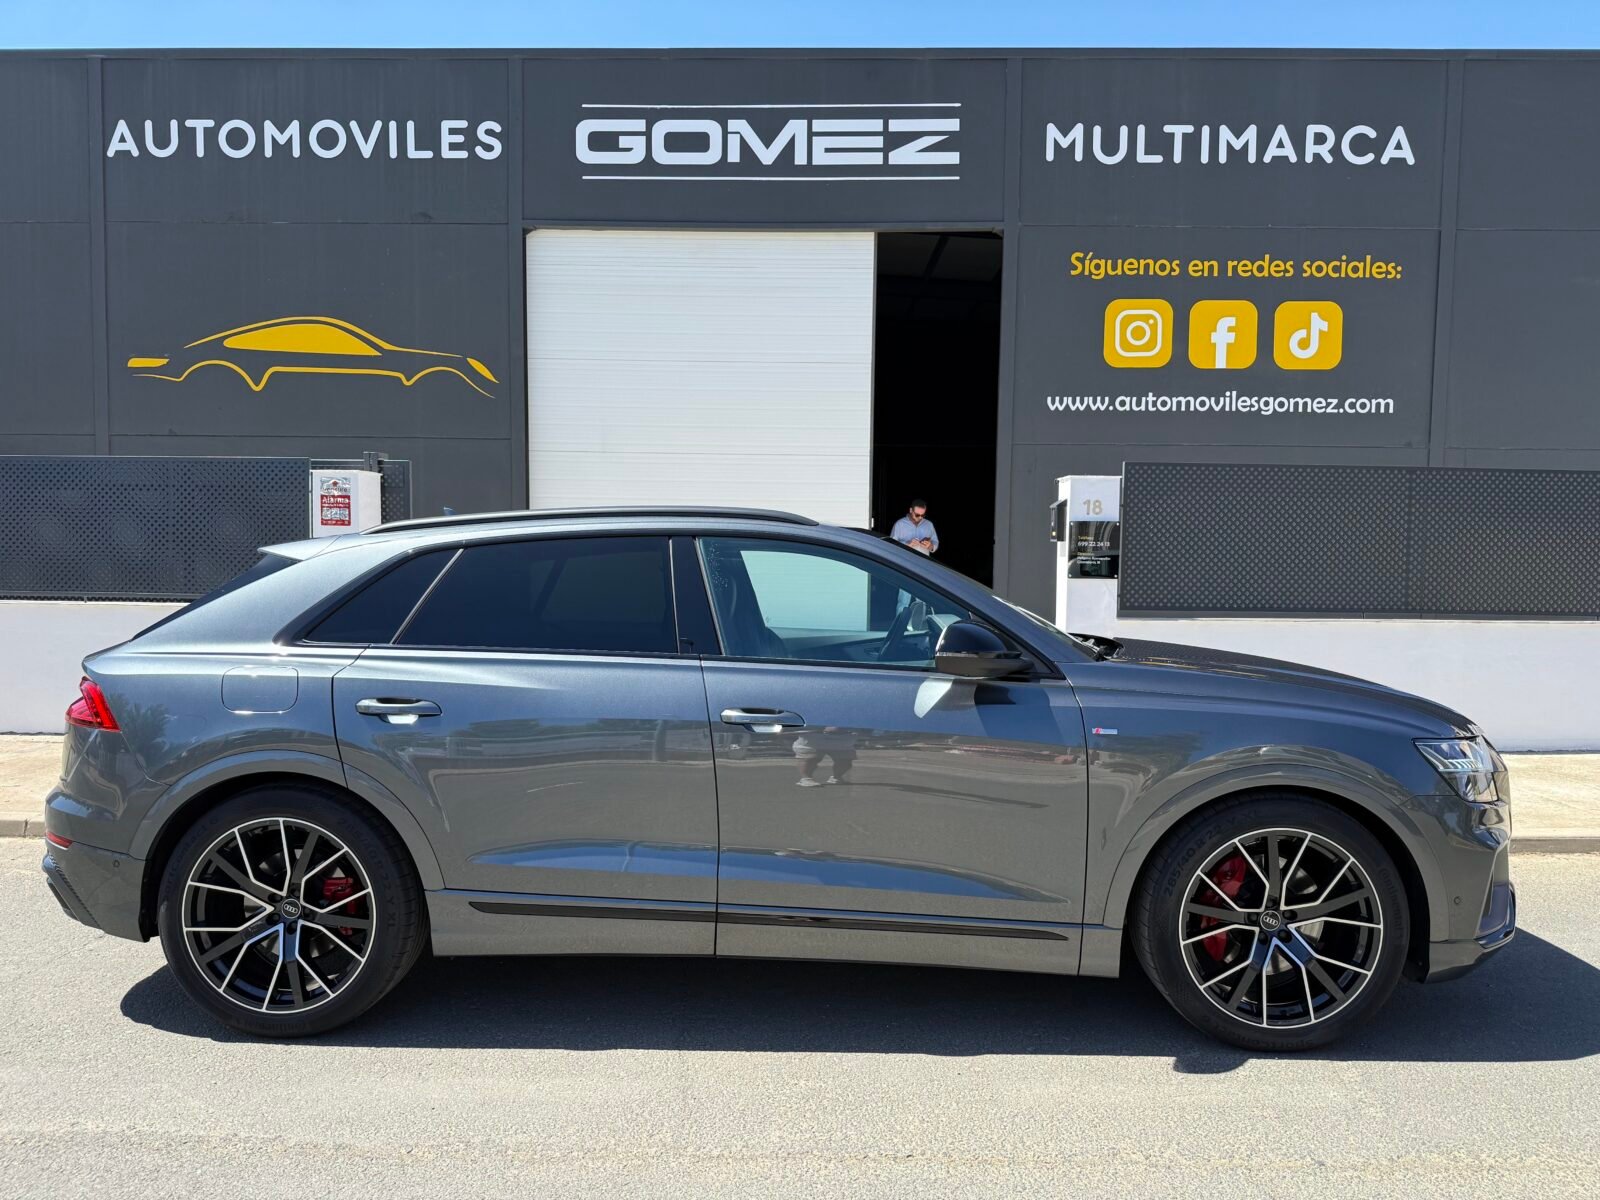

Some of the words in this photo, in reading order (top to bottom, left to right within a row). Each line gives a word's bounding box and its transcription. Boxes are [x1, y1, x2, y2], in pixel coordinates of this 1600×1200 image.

[107, 119, 503, 161] AUTOMOVILES
[575, 118, 961, 166] GOMEZ
[1045, 123, 1416, 166] MULTIMARCA
[1070, 251, 1180, 280] Síguenos
[1188, 259, 1219, 277] en
[1227, 255, 1294, 278] redes
[1303, 256, 1403, 280] sociales:
[1046, 390, 1395, 416] www.automovilesgomez.com
[1083, 499, 1103, 515] 18
